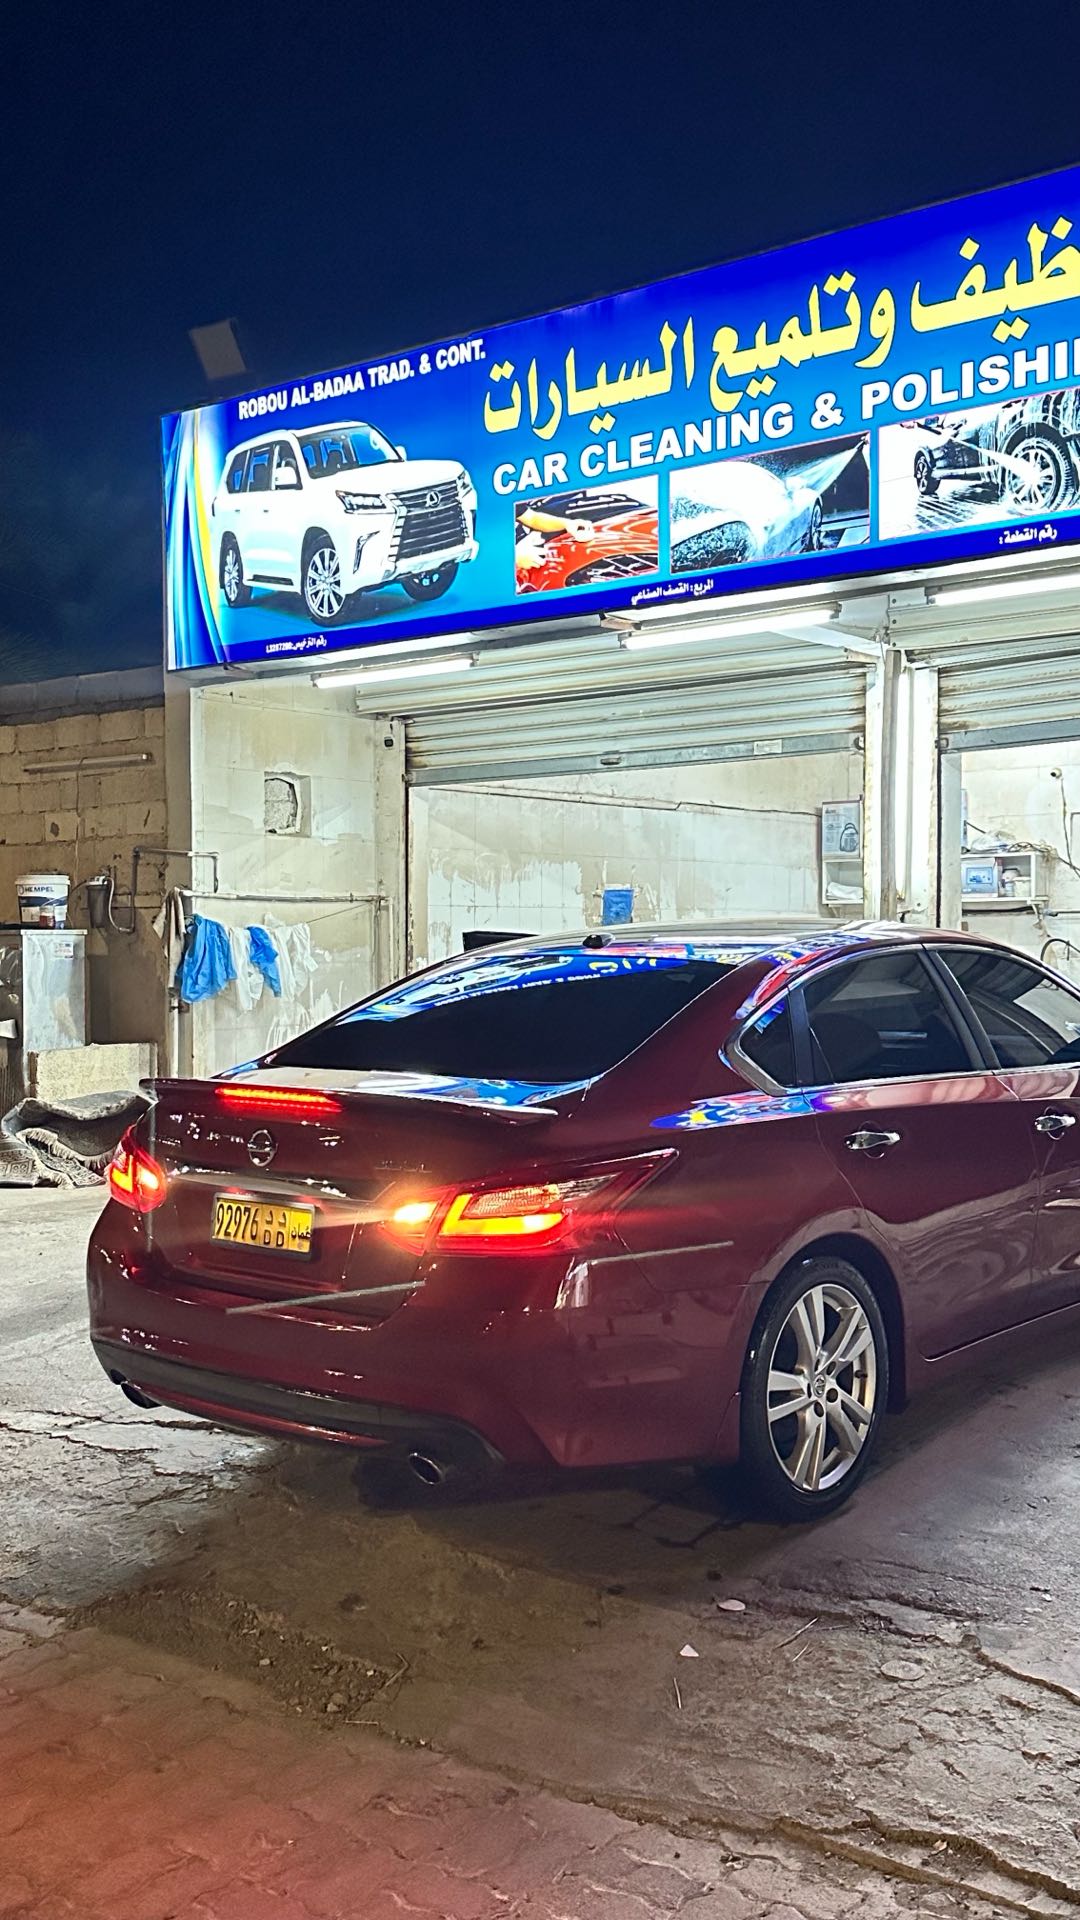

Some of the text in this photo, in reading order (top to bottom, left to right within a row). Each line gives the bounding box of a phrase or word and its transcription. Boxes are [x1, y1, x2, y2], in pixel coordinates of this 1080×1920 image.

[238, 338, 486, 420] ROBOU AL-BADAA TRAD. & CONT.
[484, 315, 695, 441] السيارات
[709, 270, 896, 413] وتلميع
[492, 452, 569, 495] CAR
[579, 402, 795, 478] CLEANING
[810, 391, 845, 430] &
[1038, 524, 1058, 542] رقم
[216, 1203, 259, 1241] 92976
